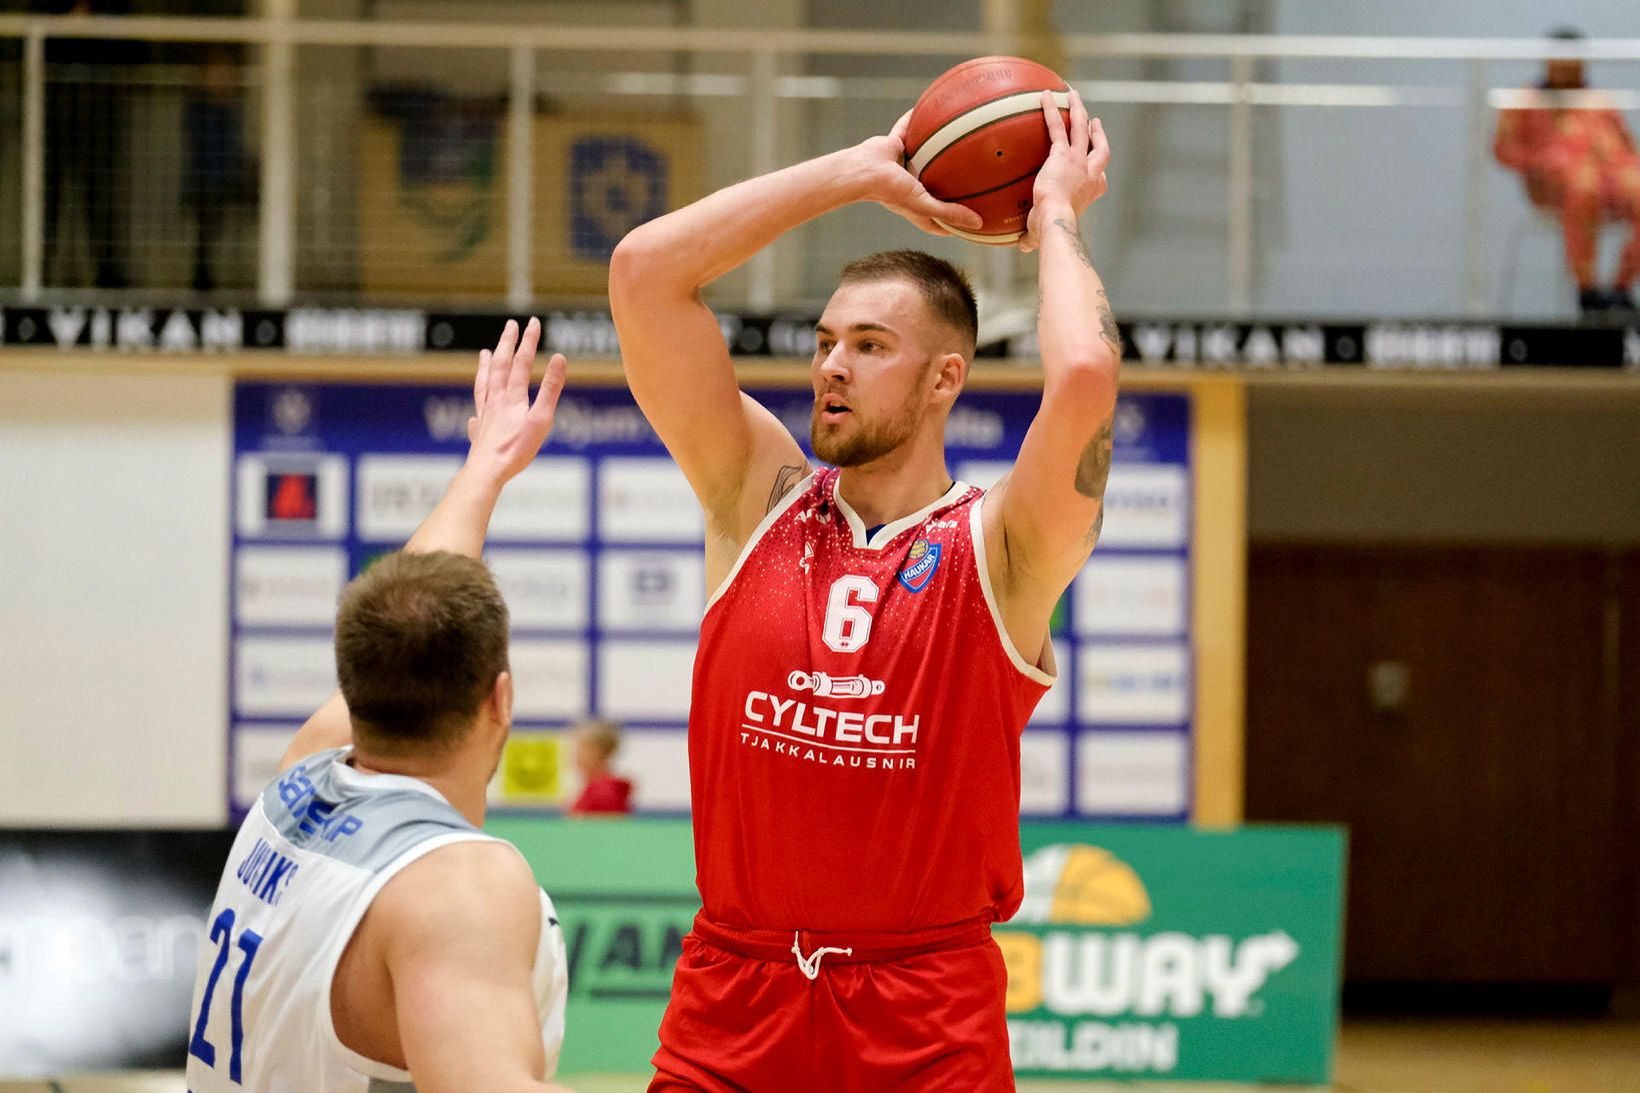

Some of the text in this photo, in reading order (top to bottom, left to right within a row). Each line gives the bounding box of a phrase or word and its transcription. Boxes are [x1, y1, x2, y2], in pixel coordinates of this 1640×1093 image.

[49, 306, 242, 351] VIKAN
[1134, 325, 1325, 365] VIKAN
[903, 553, 936, 580] HAUKAR
[822, 573, 880, 653] 6
[744, 690, 920, 744] CYLTECH
[740, 732, 916, 769] TJAKKALAUSNIR
[991, 931, 1300, 1017] BWAY
